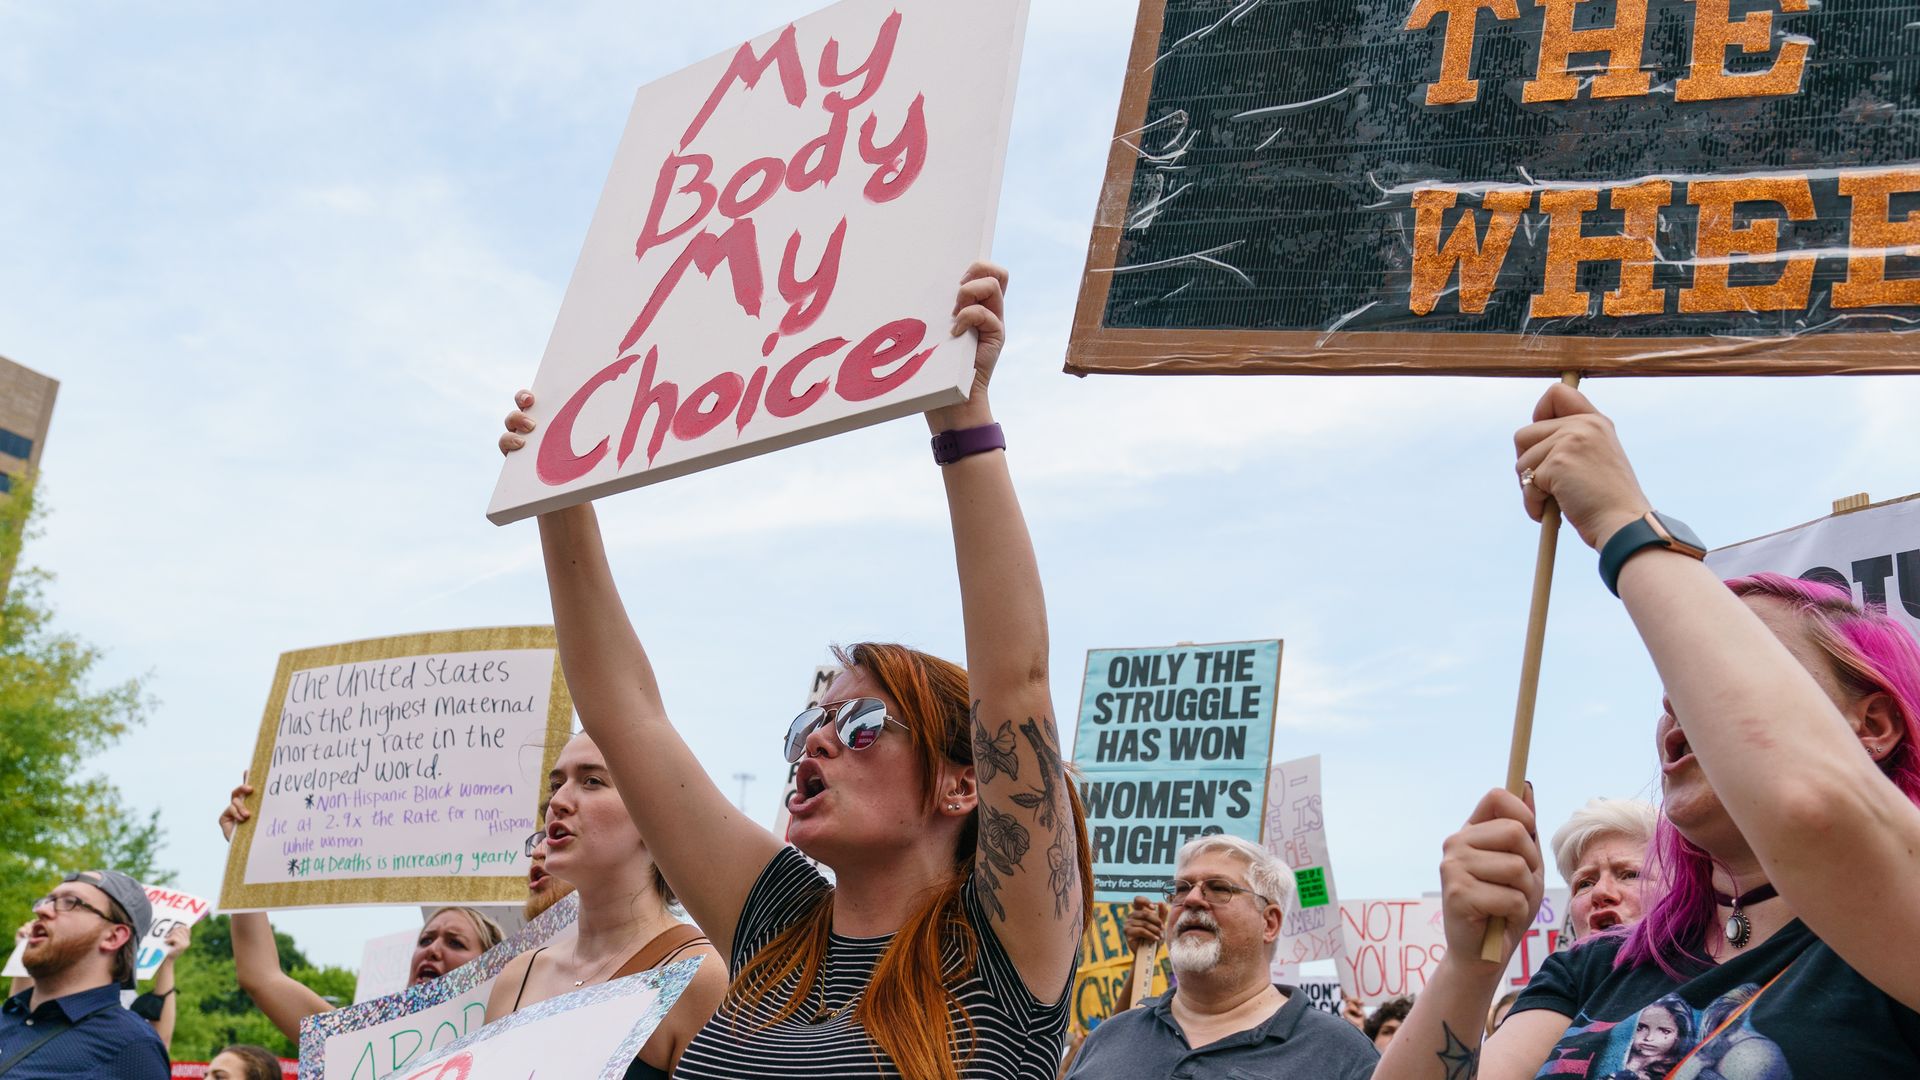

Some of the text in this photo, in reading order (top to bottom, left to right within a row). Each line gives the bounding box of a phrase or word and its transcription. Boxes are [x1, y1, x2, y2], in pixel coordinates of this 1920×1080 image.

[1404, 0, 1808, 106] THE
[679, 8, 903, 153] My
[635, 91, 928, 262] Body
[618, 214, 847, 357] My
[536, 318, 938, 486] Choice
[291, 657, 510, 704] The United States
[1107, 649, 1256, 688] ONLY THE
[278, 708, 313, 737] has
[319, 704, 353, 734] the
[359, 698, 426, 737] highest
[1093, 686, 1261, 724] STRUGGLE
[380, 731, 425, 753] rate
[432, 726, 456, 750] in
[467, 725, 505, 748] the
[1096, 725, 1247, 763] HAS WON
[268, 759, 360, 796] developed
[414, 782, 453, 803] Black
[1080, 780, 1252, 819] WOMEN'S
[297, 817, 312, 831] at
[372, 810, 394, 827] the
[393, 852, 463, 874] increasing
[472, 850, 518, 871] yearly
[144, 886, 206, 914] OMEN
[1094, 878, 1117, 889] Party
[1119, 878, 1131, 888] for
[1339, 901, 1421, 942] NOT
